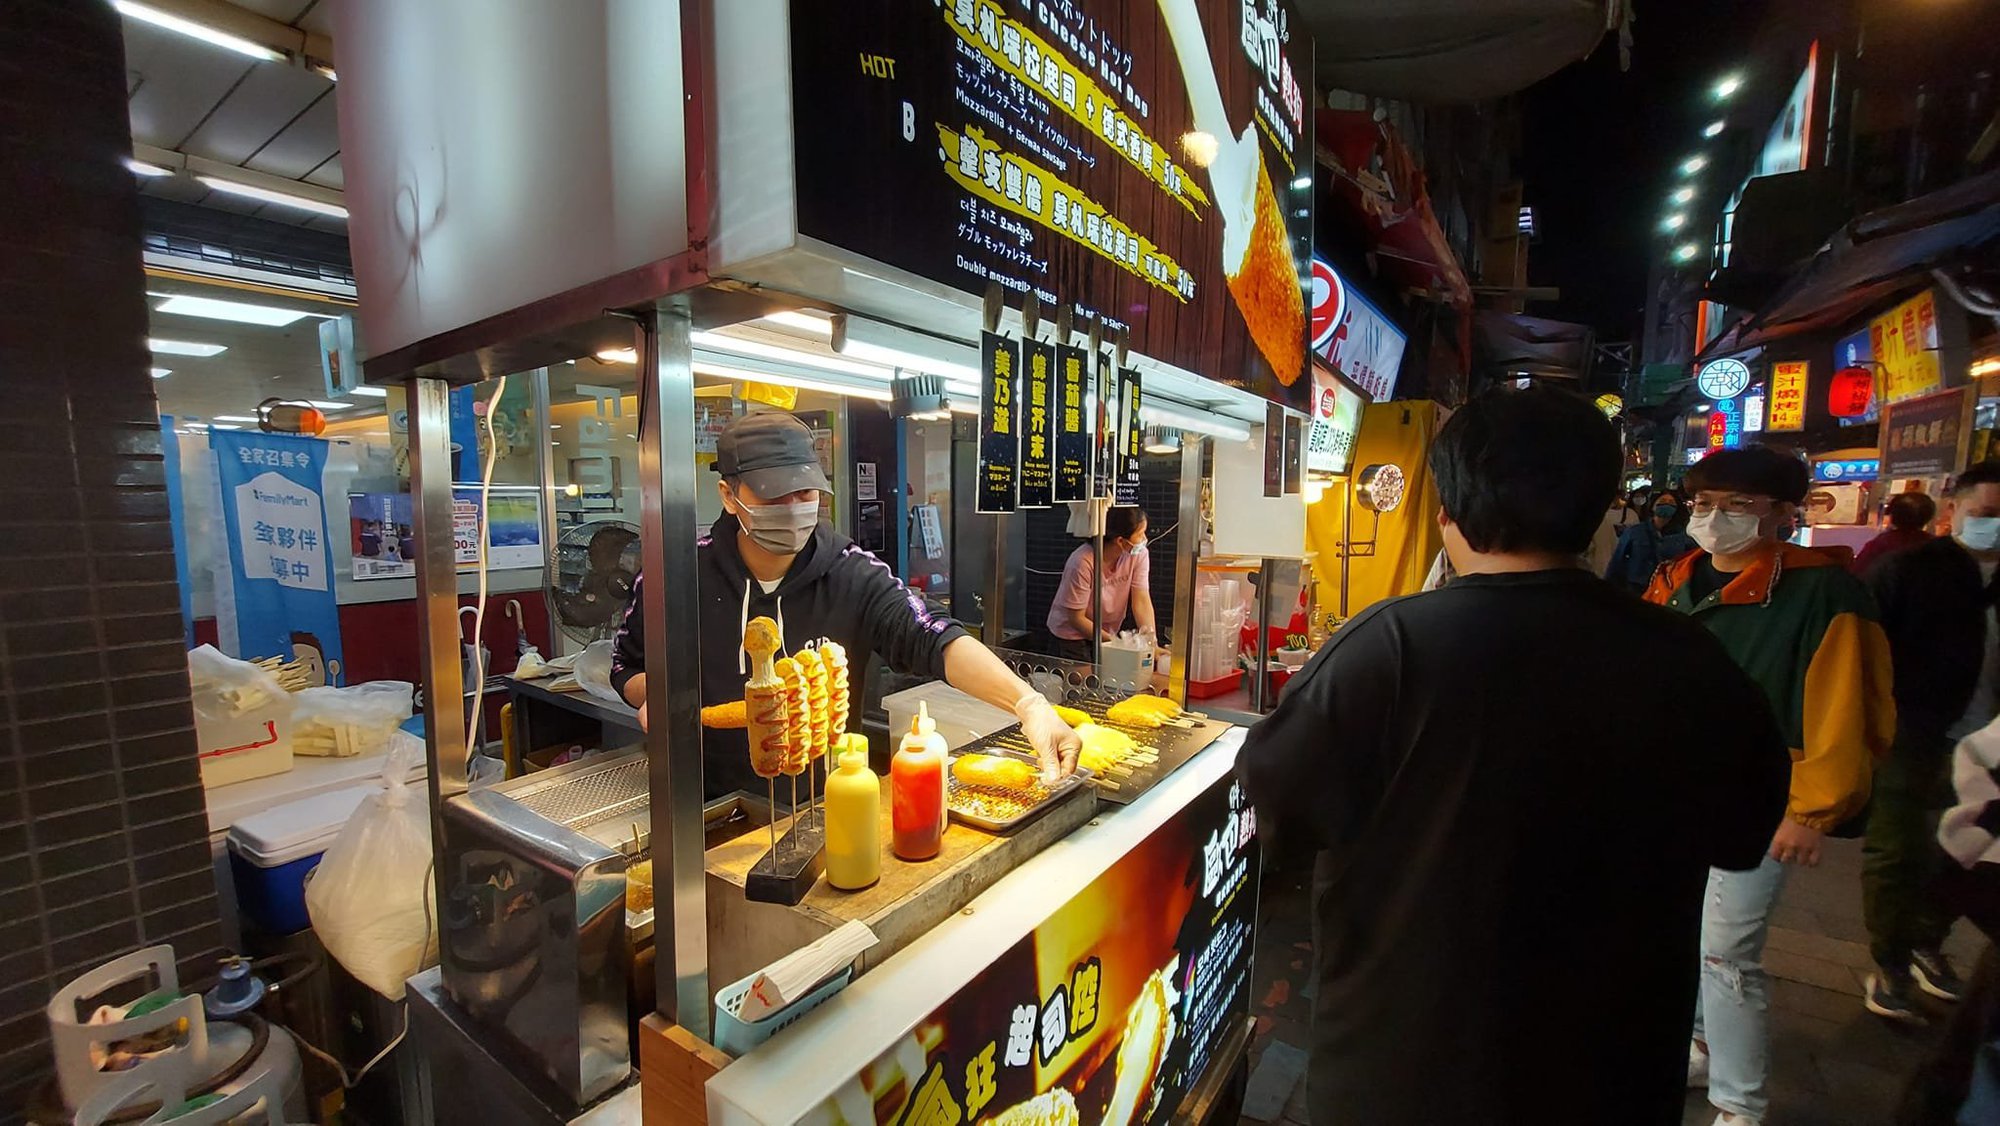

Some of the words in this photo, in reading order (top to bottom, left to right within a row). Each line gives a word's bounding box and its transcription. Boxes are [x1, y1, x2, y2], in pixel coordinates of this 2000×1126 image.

[860, 52, 896, 80] HOT
[1039, 2, 1096, 68] Cheese
[1101, 59, 1122, 93] Hot
[1126, 83, 1148, 118] Dog
[903, 101, 915, 142] B
[956, 86, 1005, 129] Mozzarella
[1016, 129, 1041, 154] German
[959, 135, 1042, 215] 整支雙倍
[958, 222, 982, 244] ダブル
[956, 254, 987, 277] Double
[1033, 287, 1057, 305] heese
[993, 348, 1011, 434] 美乃滋
[239, 446, 311, 469] 全家召集令
[253, 489, 310, 507] FamilyMart
